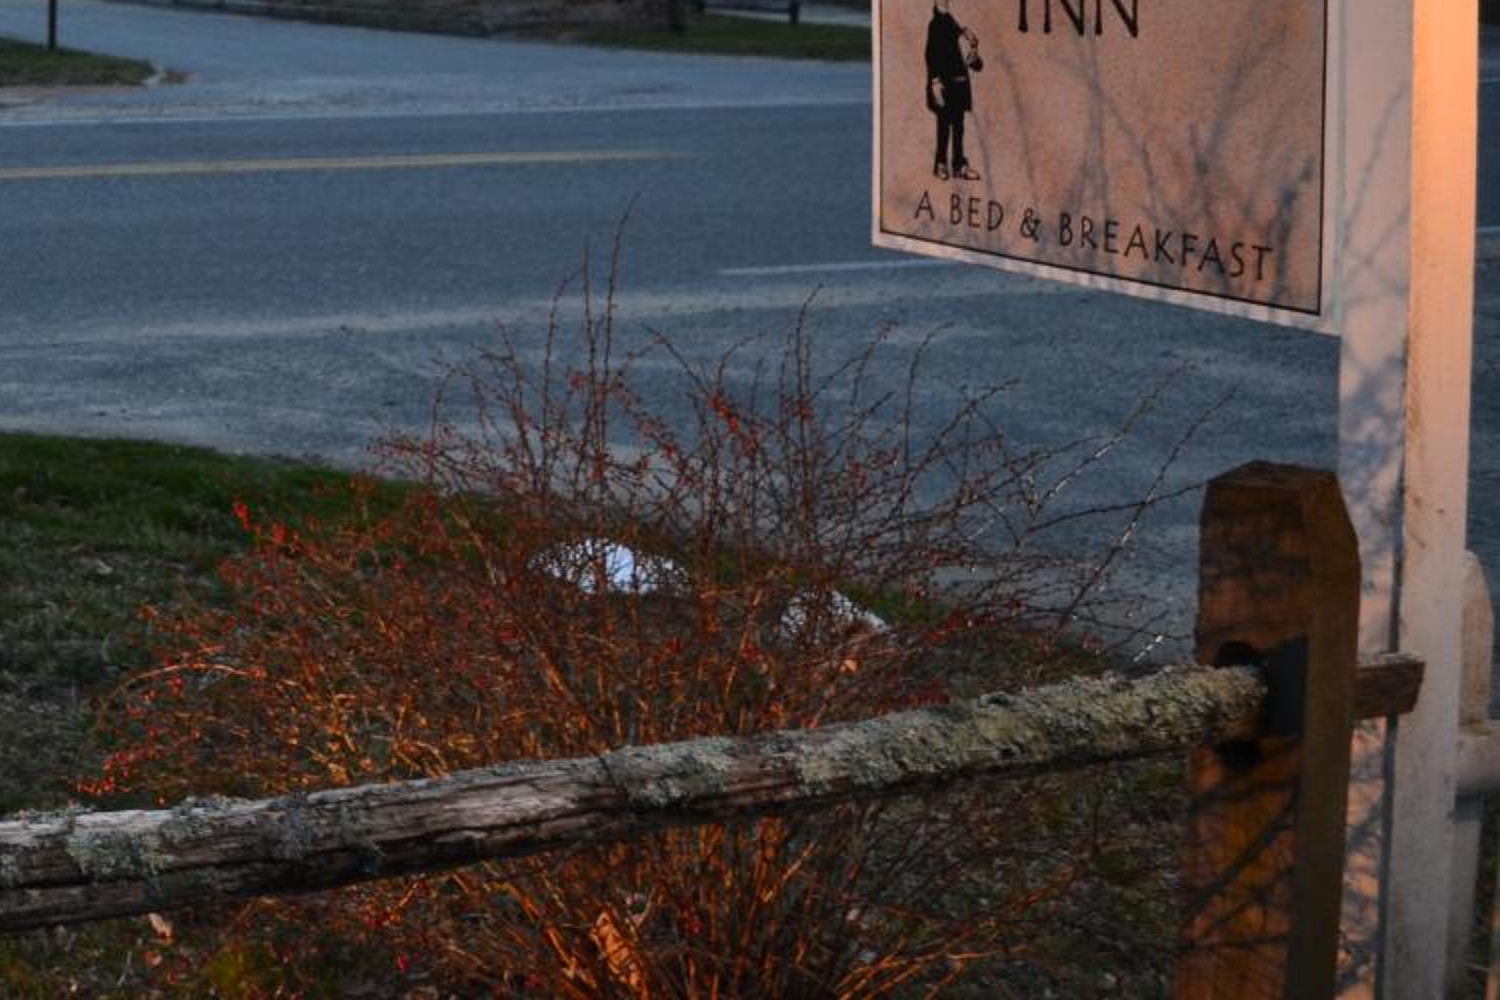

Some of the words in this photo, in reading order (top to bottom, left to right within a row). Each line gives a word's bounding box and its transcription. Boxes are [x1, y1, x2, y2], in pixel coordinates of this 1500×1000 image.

[913, 190, 935, 221] A
[950, 193, 1004, 232] BED
[1019, 207, 1041, 243] &
[1059, 211, 1273, 281] BREAKFAST
